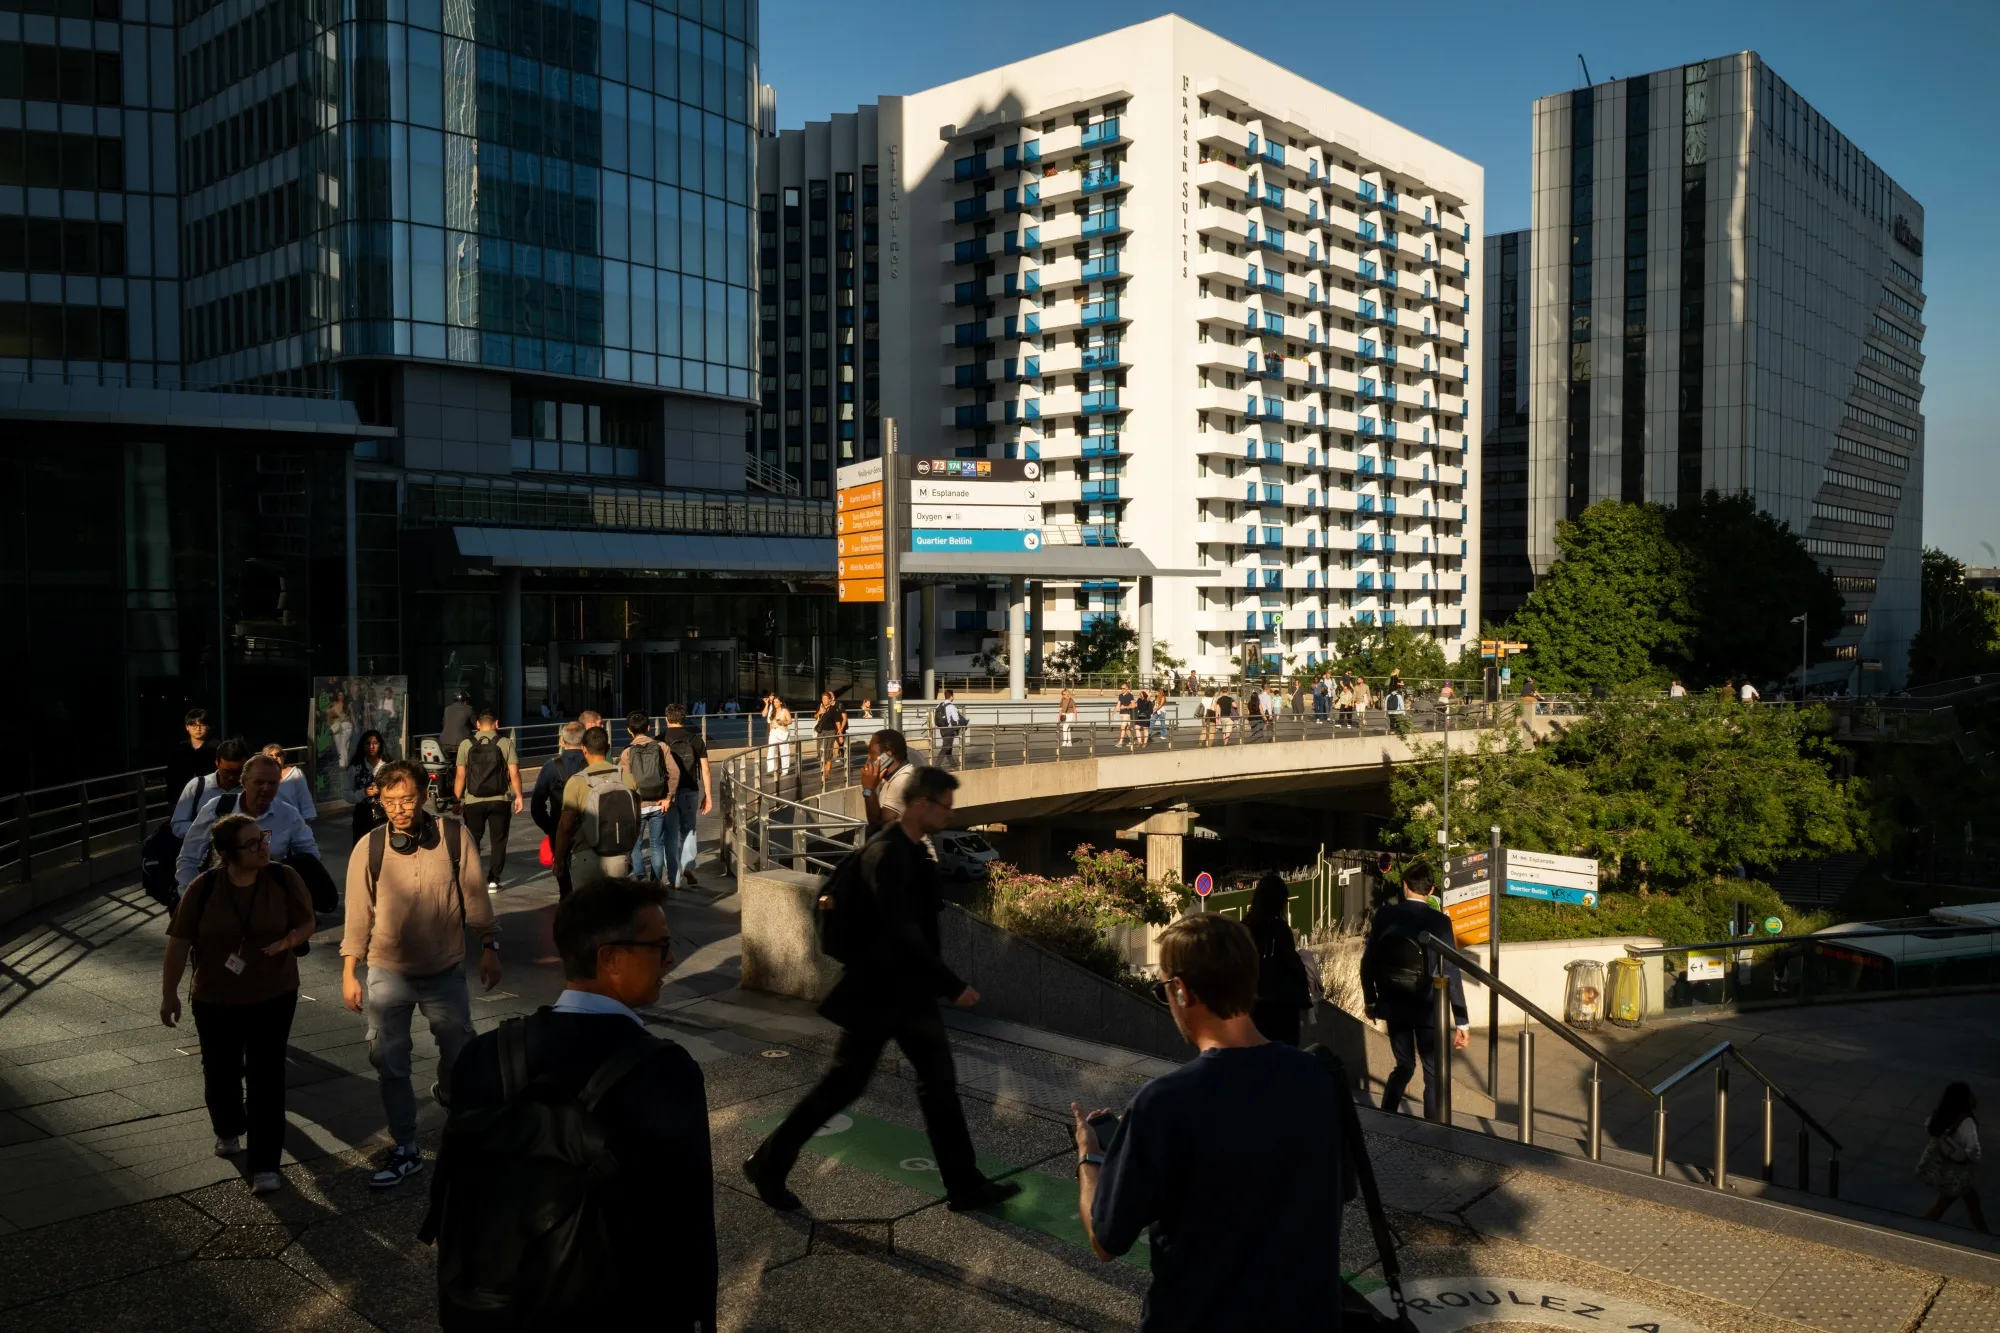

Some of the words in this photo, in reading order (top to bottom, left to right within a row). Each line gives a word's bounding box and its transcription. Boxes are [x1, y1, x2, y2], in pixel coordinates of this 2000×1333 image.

[888, 144, 899, 280] Citadines
[933, 461, 945, 470] 73
[948, 462, 960, 470] 174
[919, 488, 927, 496] M
[932, 488, 970, 498] Esplanade
[916, 512, 942, 521] Oxygen
[916, 536, 948, 545] Quartier
[949, 536, 972, 545] Bellini
[1529, 856, 1555, 865] Esplanade
[1509, 884, 1531, 893] Quartier
[1531, 887, 1548, 895] Bellini
[1406, 1289, 1605, 1320] ROULEZ
